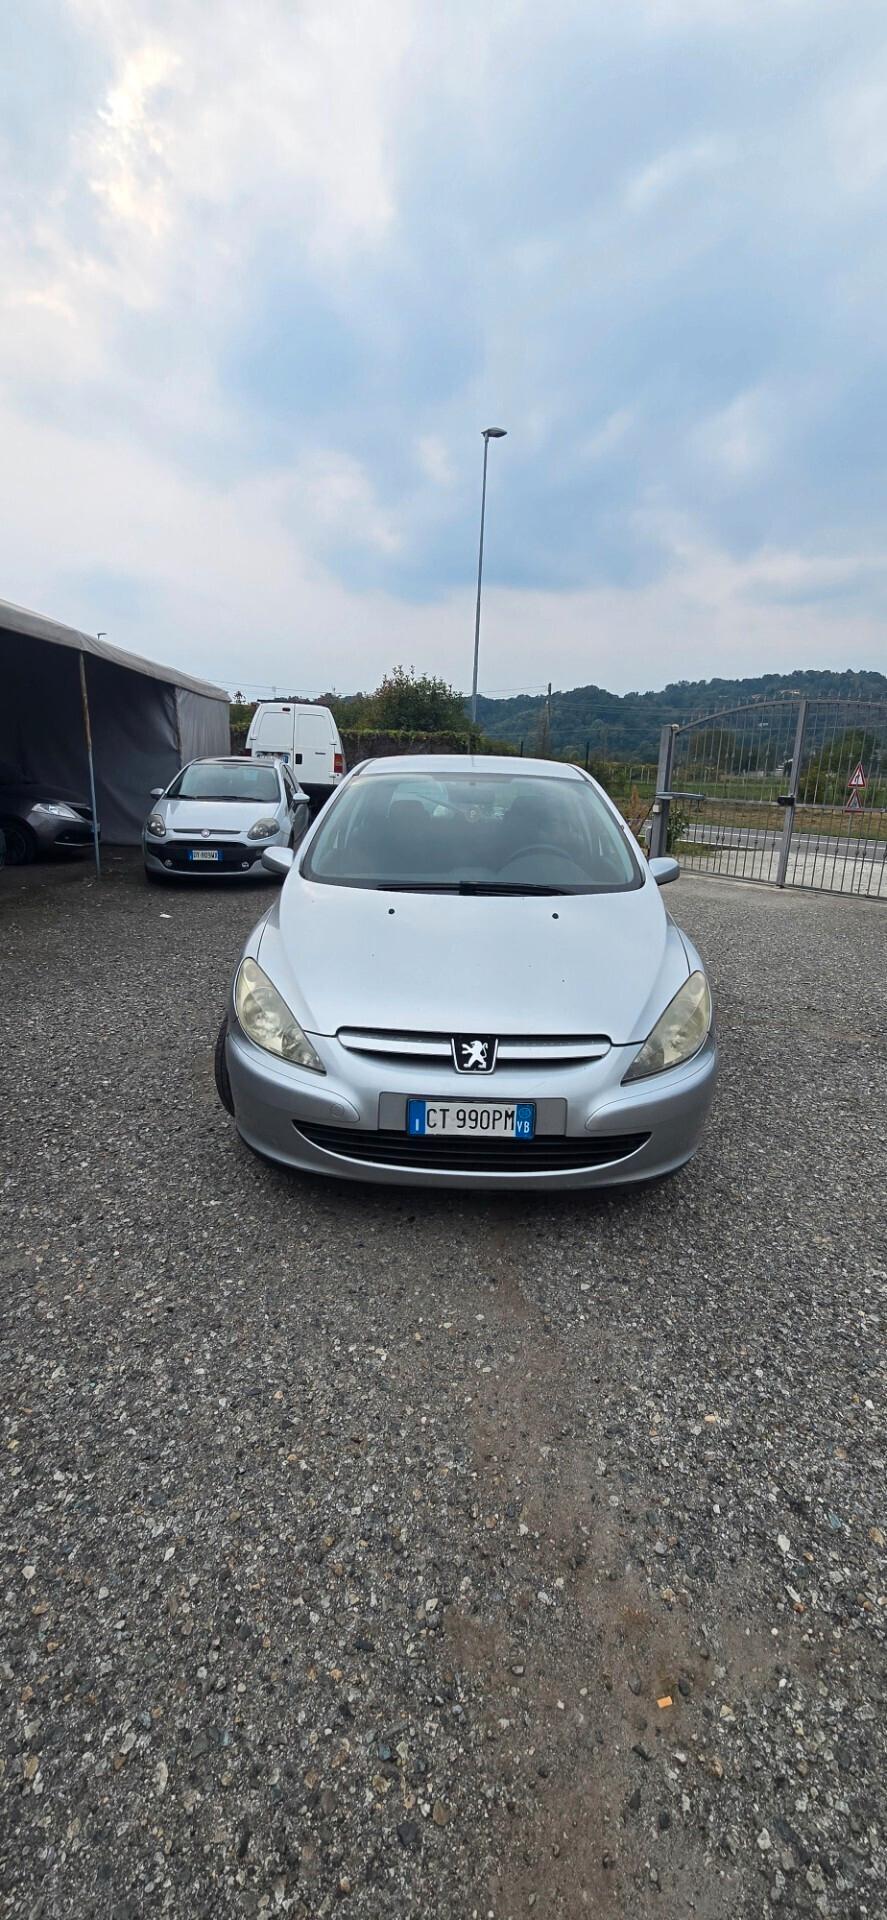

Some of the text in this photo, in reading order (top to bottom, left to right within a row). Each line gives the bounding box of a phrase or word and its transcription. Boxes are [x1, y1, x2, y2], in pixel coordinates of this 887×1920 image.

[426, 1108, 450, 1129] CT
[456, 1108, 515, 1131] 990PM
[517, 1120, 530, 1133] VB
